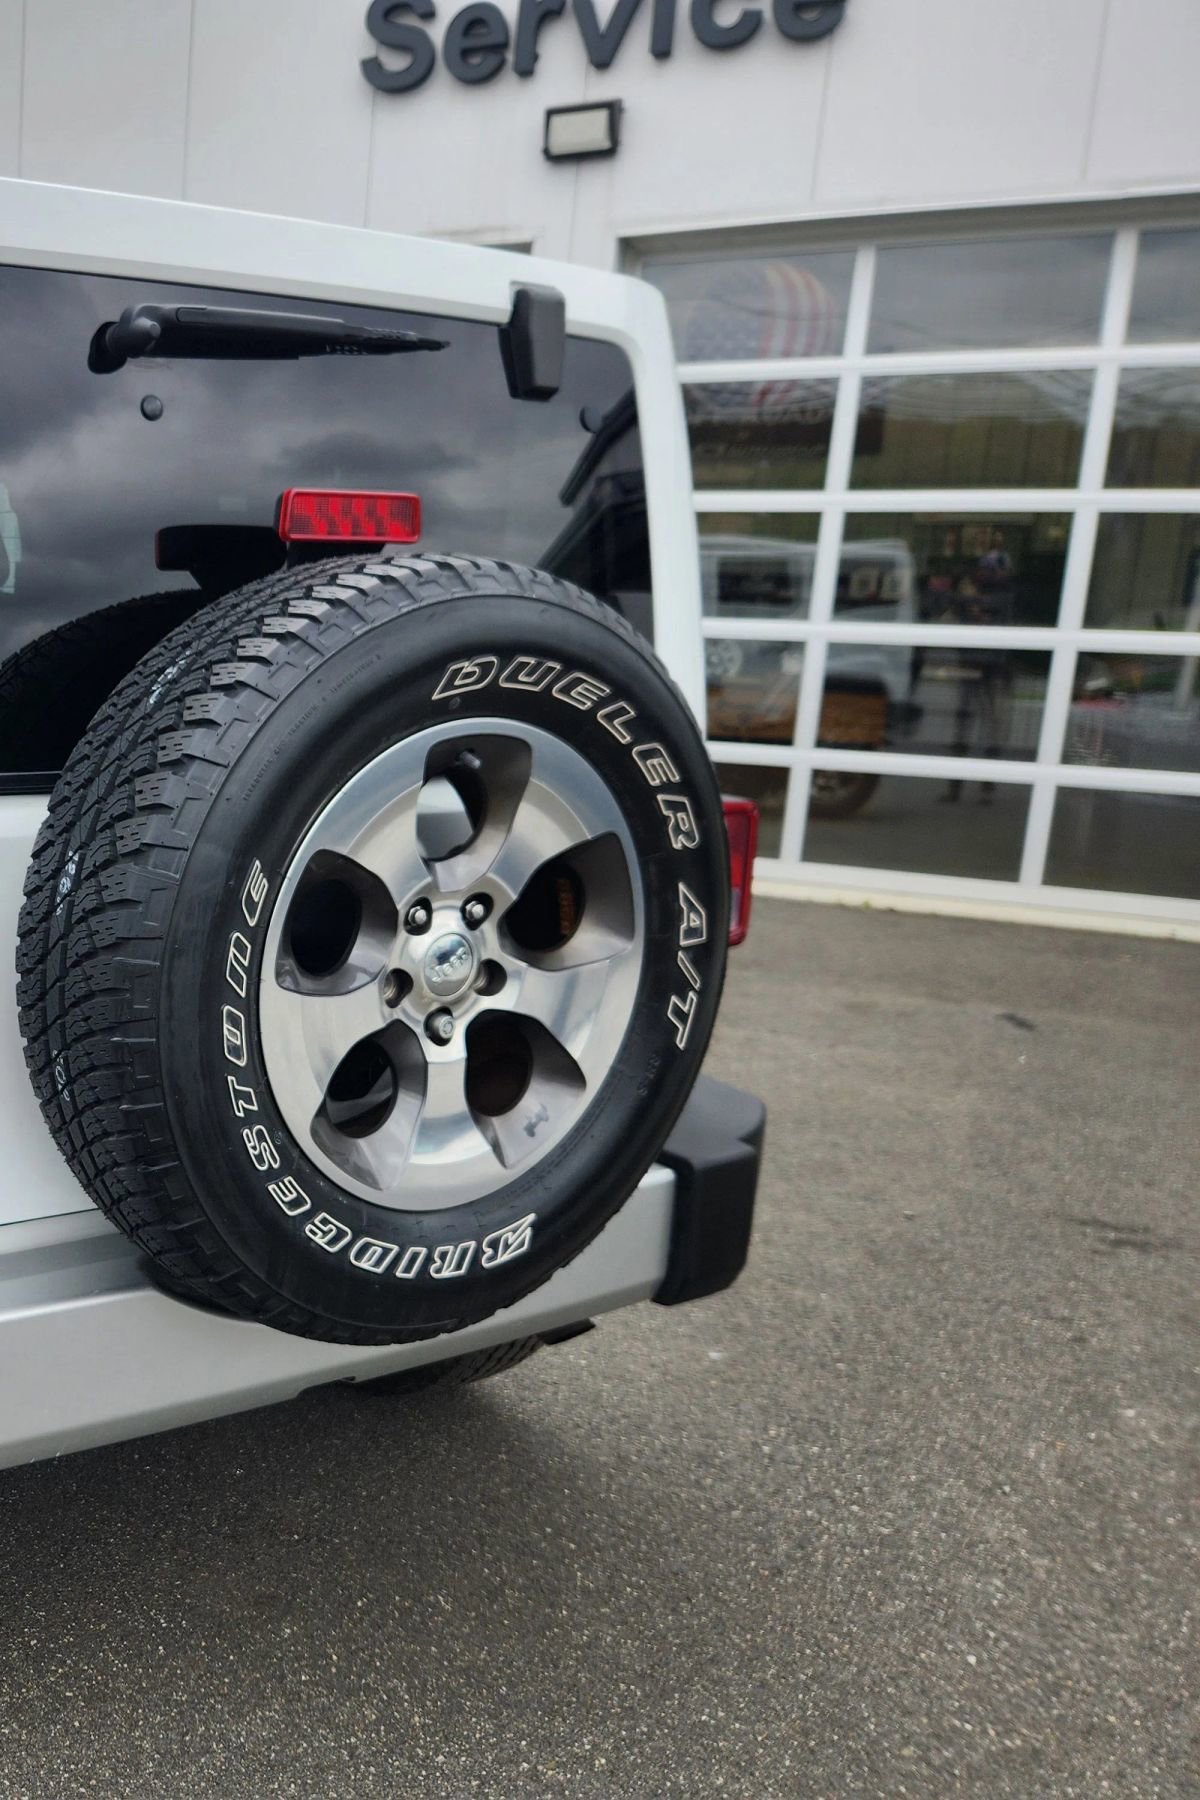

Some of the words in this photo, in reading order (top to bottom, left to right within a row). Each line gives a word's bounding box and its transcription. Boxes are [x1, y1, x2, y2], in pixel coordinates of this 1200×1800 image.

[431, 655, 700, 850] DUELER
[667, 881, 709, 1051] A/T
[221, 858, 538, 1280] BRIDGESTONE
